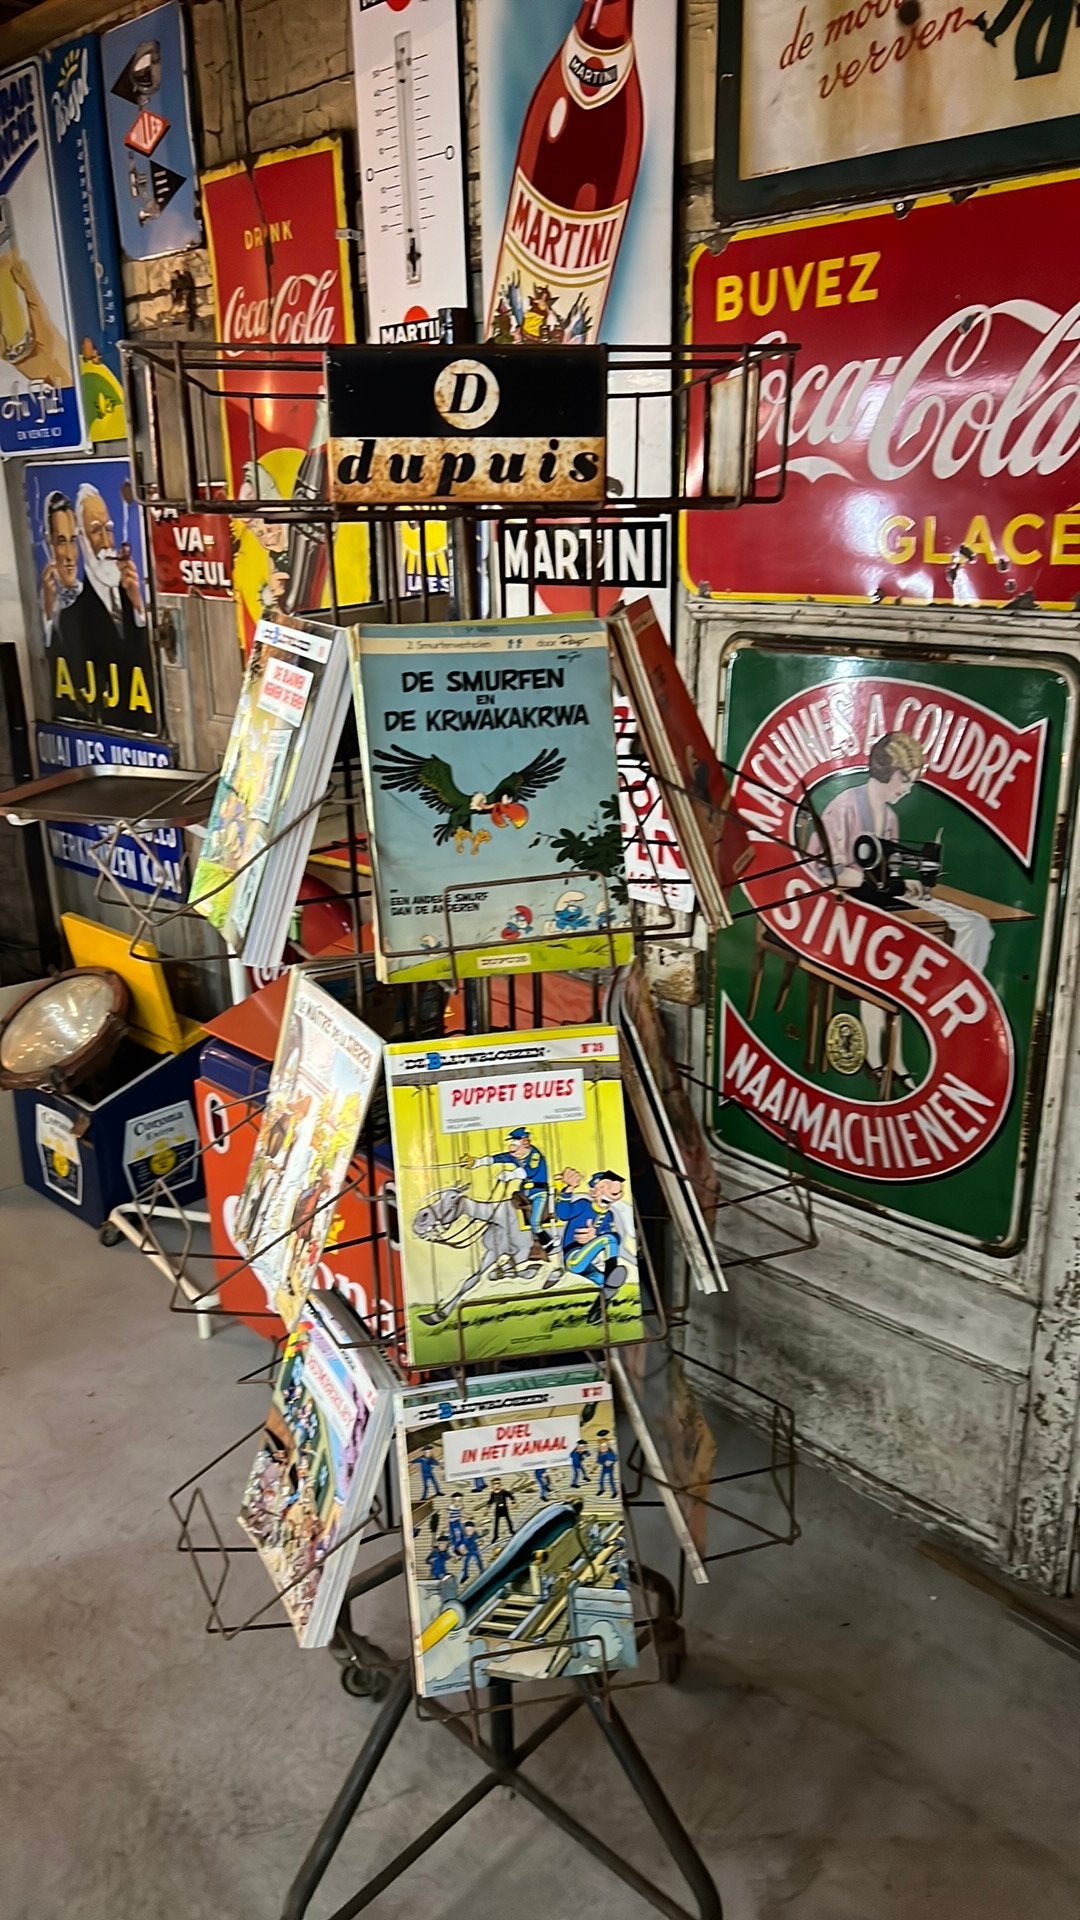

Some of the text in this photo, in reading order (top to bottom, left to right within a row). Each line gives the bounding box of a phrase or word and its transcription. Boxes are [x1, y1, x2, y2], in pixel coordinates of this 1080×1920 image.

[780, 0, 902, 70] de moo
[818, 7, 976, 99] verven
[569, 57, 617, 84] MARTINI
[244, 220, 293, 250] DRNK
[511, 189, 619, 269] MARTINI
[224, 269, 338, 357] Coca-Cola
[716, 251, 882, 322] BUVEZ
[381, 319, 440, 345] MARTI
[443, 371, 488, 415] D
[337, 438, 599, 497] dupuis
[504, 528, 662, 582] MARTINI
[878, 502, 1080, 566] GLACÉ
[179, 559, 231, 587] SEUL
[55, 656, 153, 714] AJJA
[401, 667, 566, 693] DE SMURFEN
[476, 694, 496, 705] EN
[384, 704, 590, 732] DE KRWAKAKRWA
[738, 691, 862, 844] MACHINES
[771, 877, 989, 1039] SINGER
[451, 1078, 575, 1107] PUPPET BLUES
[725, 1043, 996, 1169] NAAIMACHIENEN
[461, 1436, 568, 1464] IN HET KANAAL
[496, 1423, 532, 1441] DUEL
